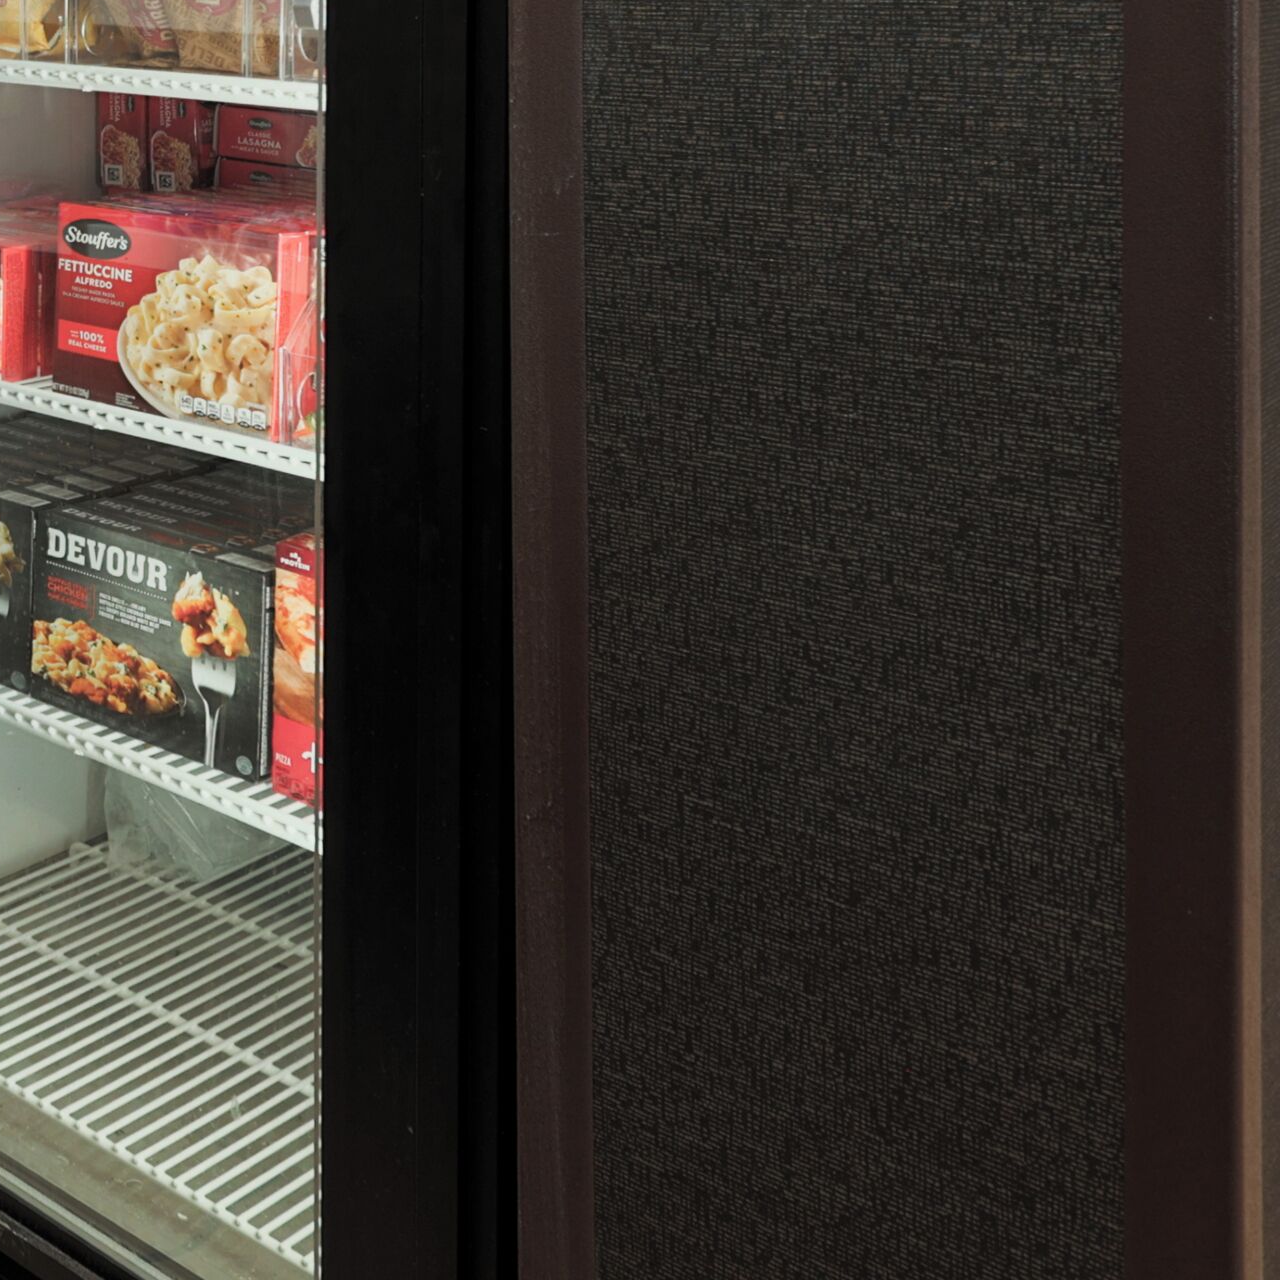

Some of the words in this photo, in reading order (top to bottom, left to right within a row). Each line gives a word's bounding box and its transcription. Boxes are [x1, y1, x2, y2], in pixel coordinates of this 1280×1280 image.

[236, 136, 282, 151] LASAGNA
[65, 226, 129, 251] Stouffer's
[58, 258, 133, 283] FETTUCCINE
[74, 276, 113, 290] ALFREDO
[79, 330, 105, 344] 100%
[67, 339, 83, 350] REAL
[83, 342, 107, 353] CHEESE
[62, 507, 142, 532] DEVOUR
[47, 527, 167, 591] DEVOUR
[280, 556, 310, 572] PROTEIN
[48, 582, 87, 600] CHICKEN
